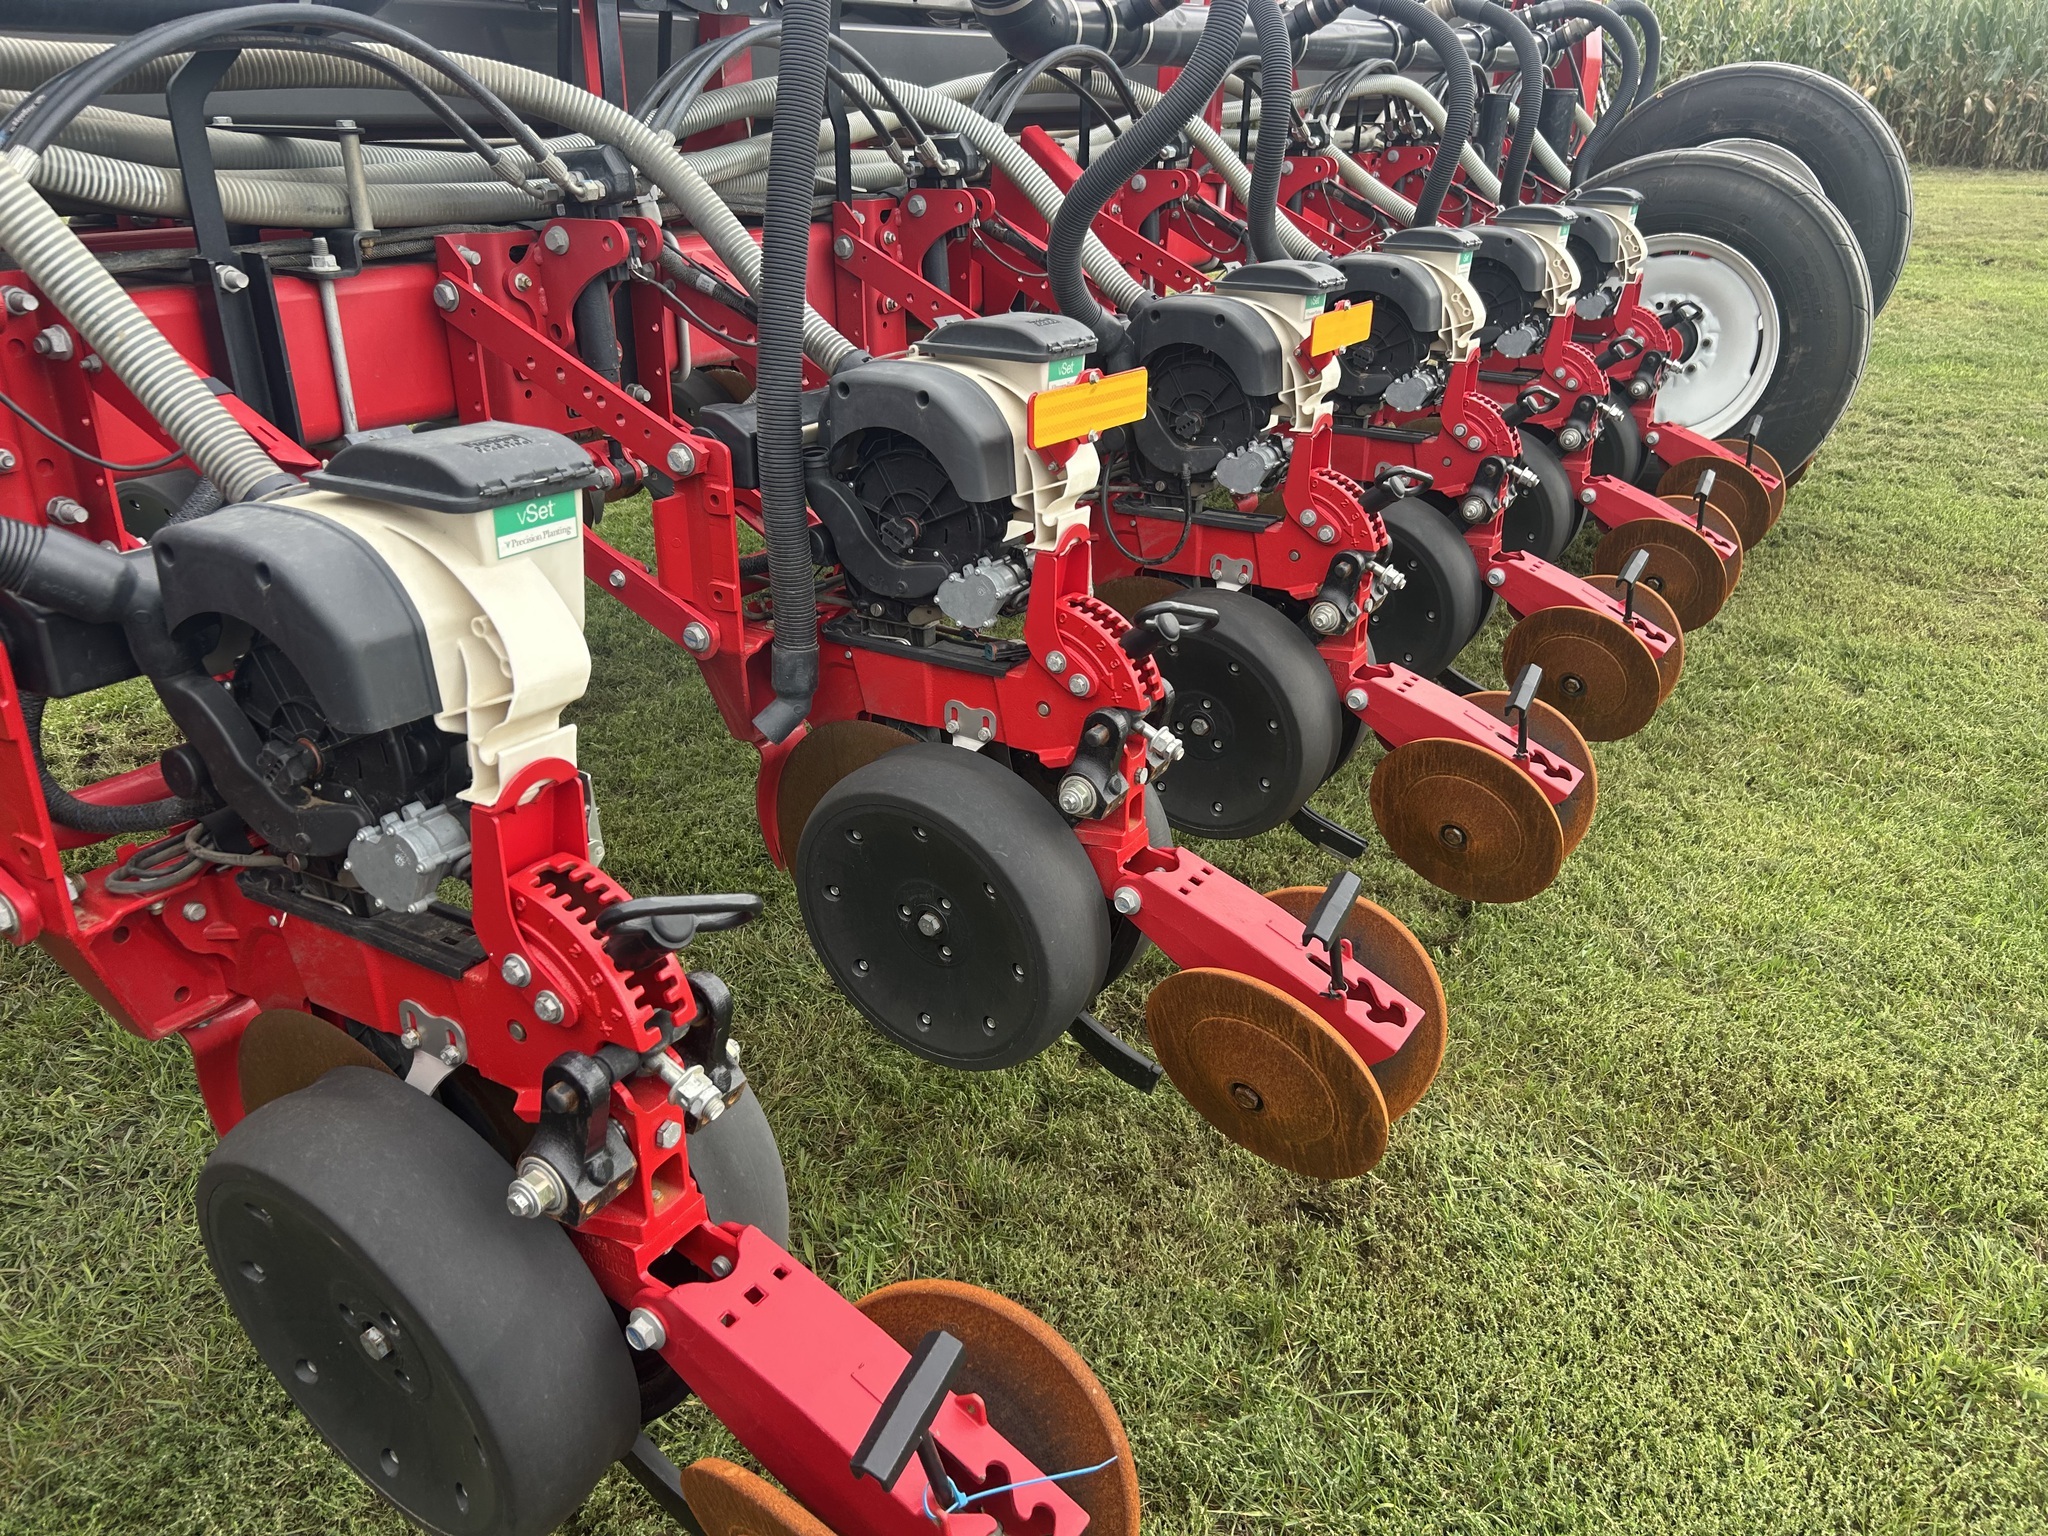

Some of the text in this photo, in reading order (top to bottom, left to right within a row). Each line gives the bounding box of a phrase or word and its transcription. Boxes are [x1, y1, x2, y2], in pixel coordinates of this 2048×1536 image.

[1058, 361, 1074, 376] vSet
[516, 500, 556, 525] vSet
[511, 526, 572, 548] Precision Planting
